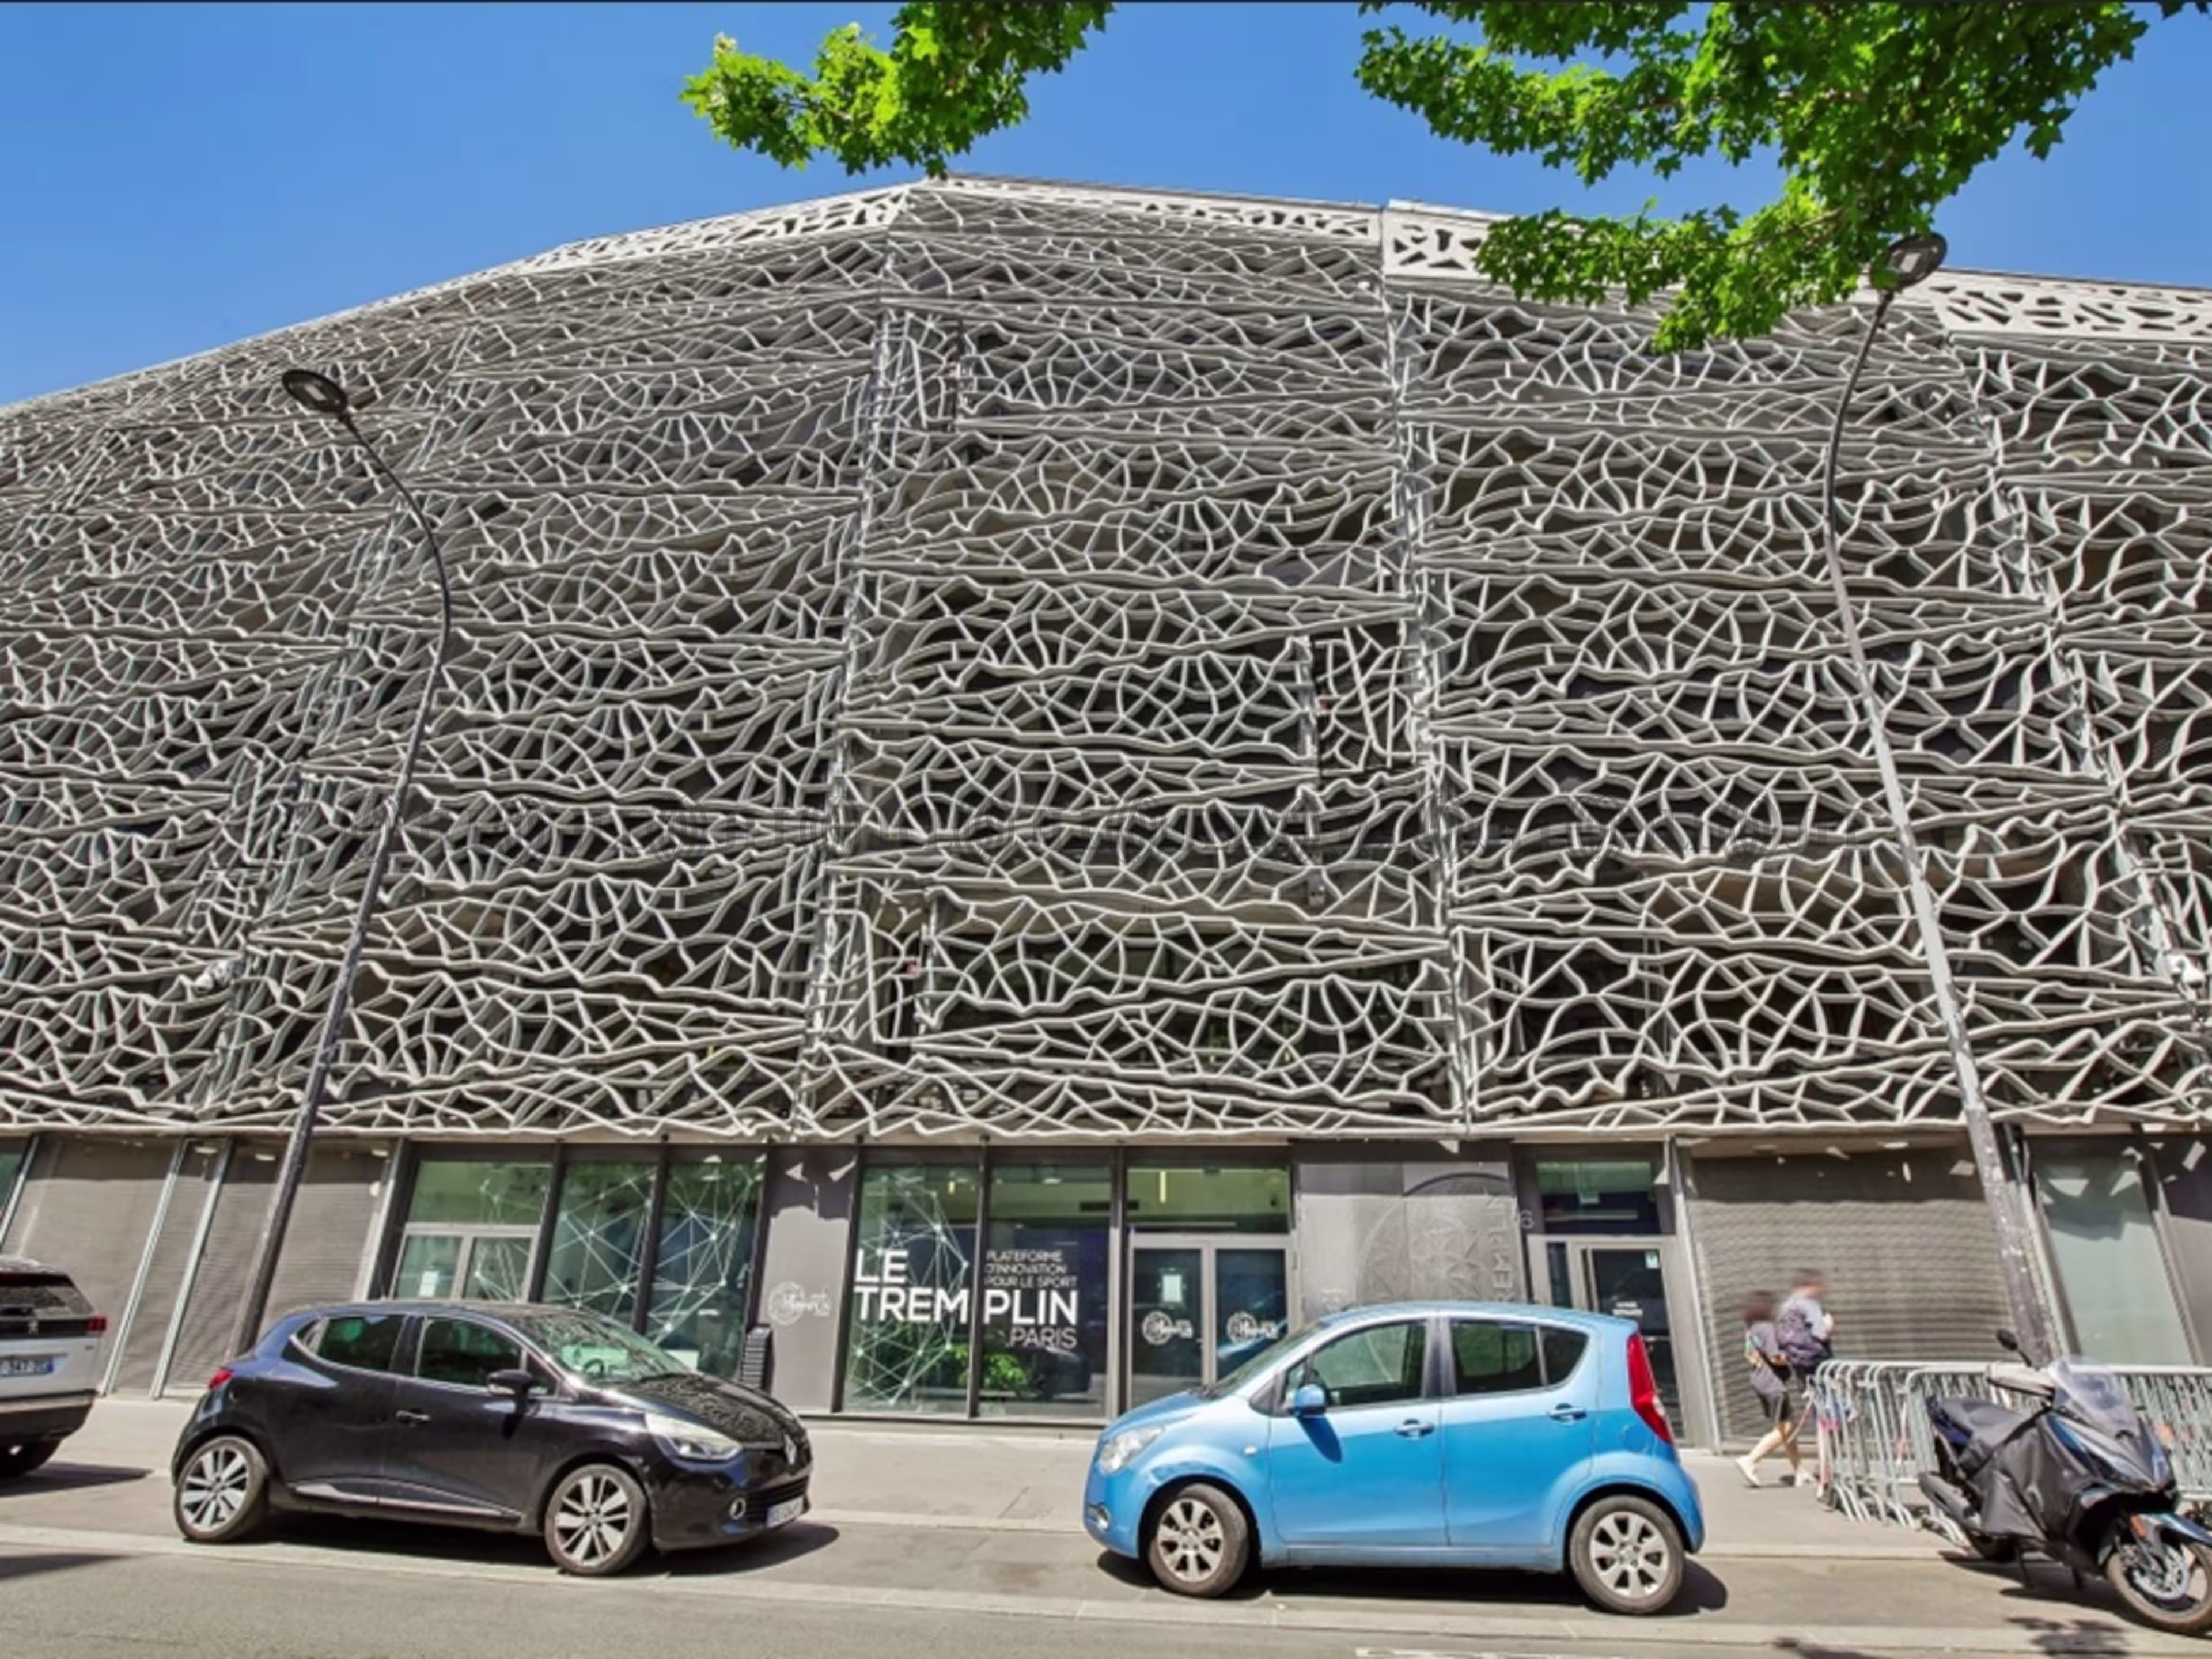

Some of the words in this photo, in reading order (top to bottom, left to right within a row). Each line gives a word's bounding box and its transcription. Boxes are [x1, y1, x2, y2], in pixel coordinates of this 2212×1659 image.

[986, 1248, 1063, 1262] PLATEFORME
[1485, 1188, 1514, 1302] REMPLIN
[855, 1248, 910, 1284] LE
[984, 1274, 1018, 1286] POUR
[1020, 1275, 1033, 1288] LE
[1037, 1275, 1078, 1289] SPORT
